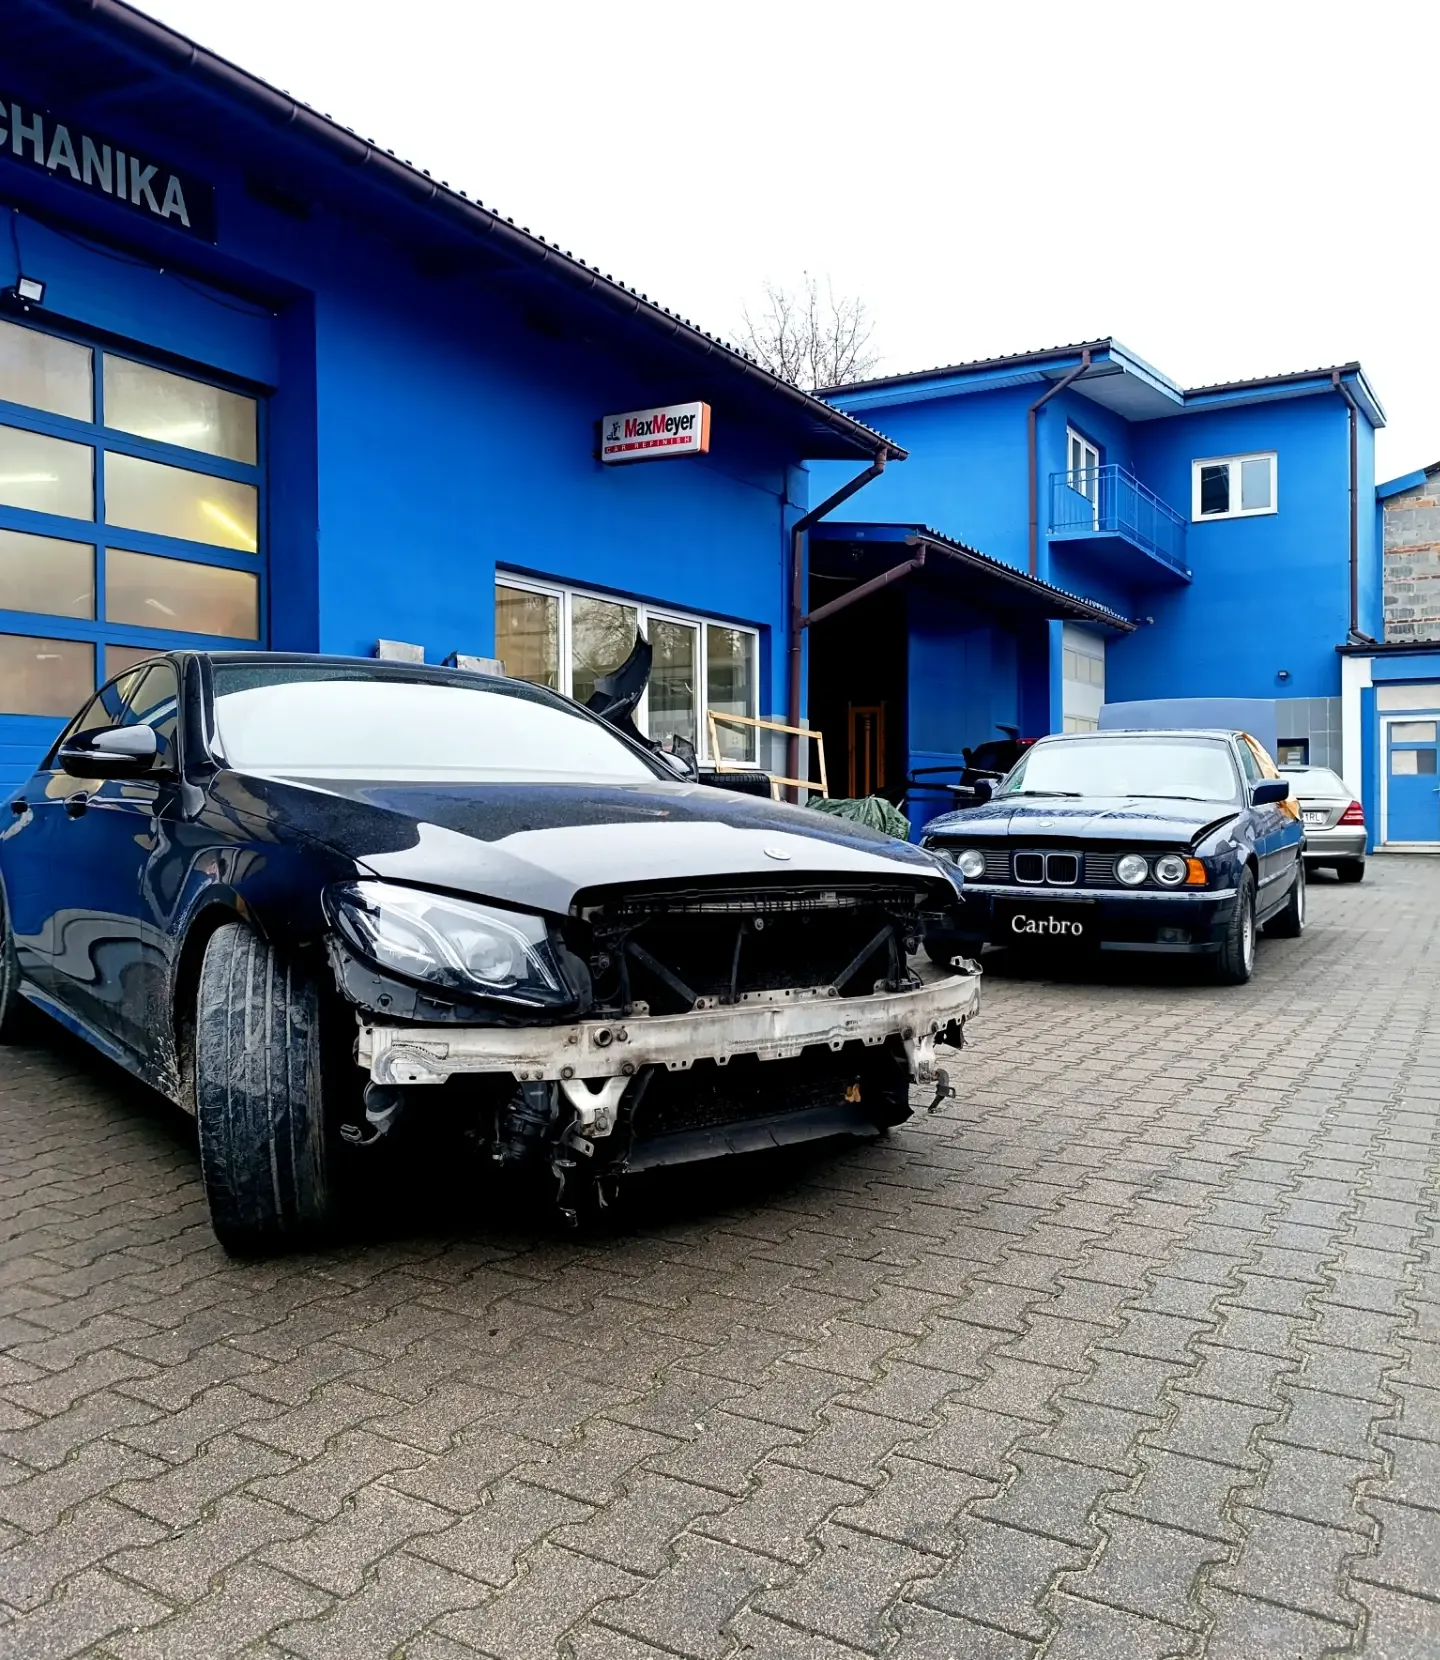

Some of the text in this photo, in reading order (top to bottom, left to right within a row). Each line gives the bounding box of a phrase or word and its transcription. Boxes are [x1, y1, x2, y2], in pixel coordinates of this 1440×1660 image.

[0, 101, 191, 228] HANIKA
[624, 414, 696, 438] MaxMeyer
[606, 436, 690, 453] CAR REFINISH
[1011, 914, 1083, 936] Carbro
